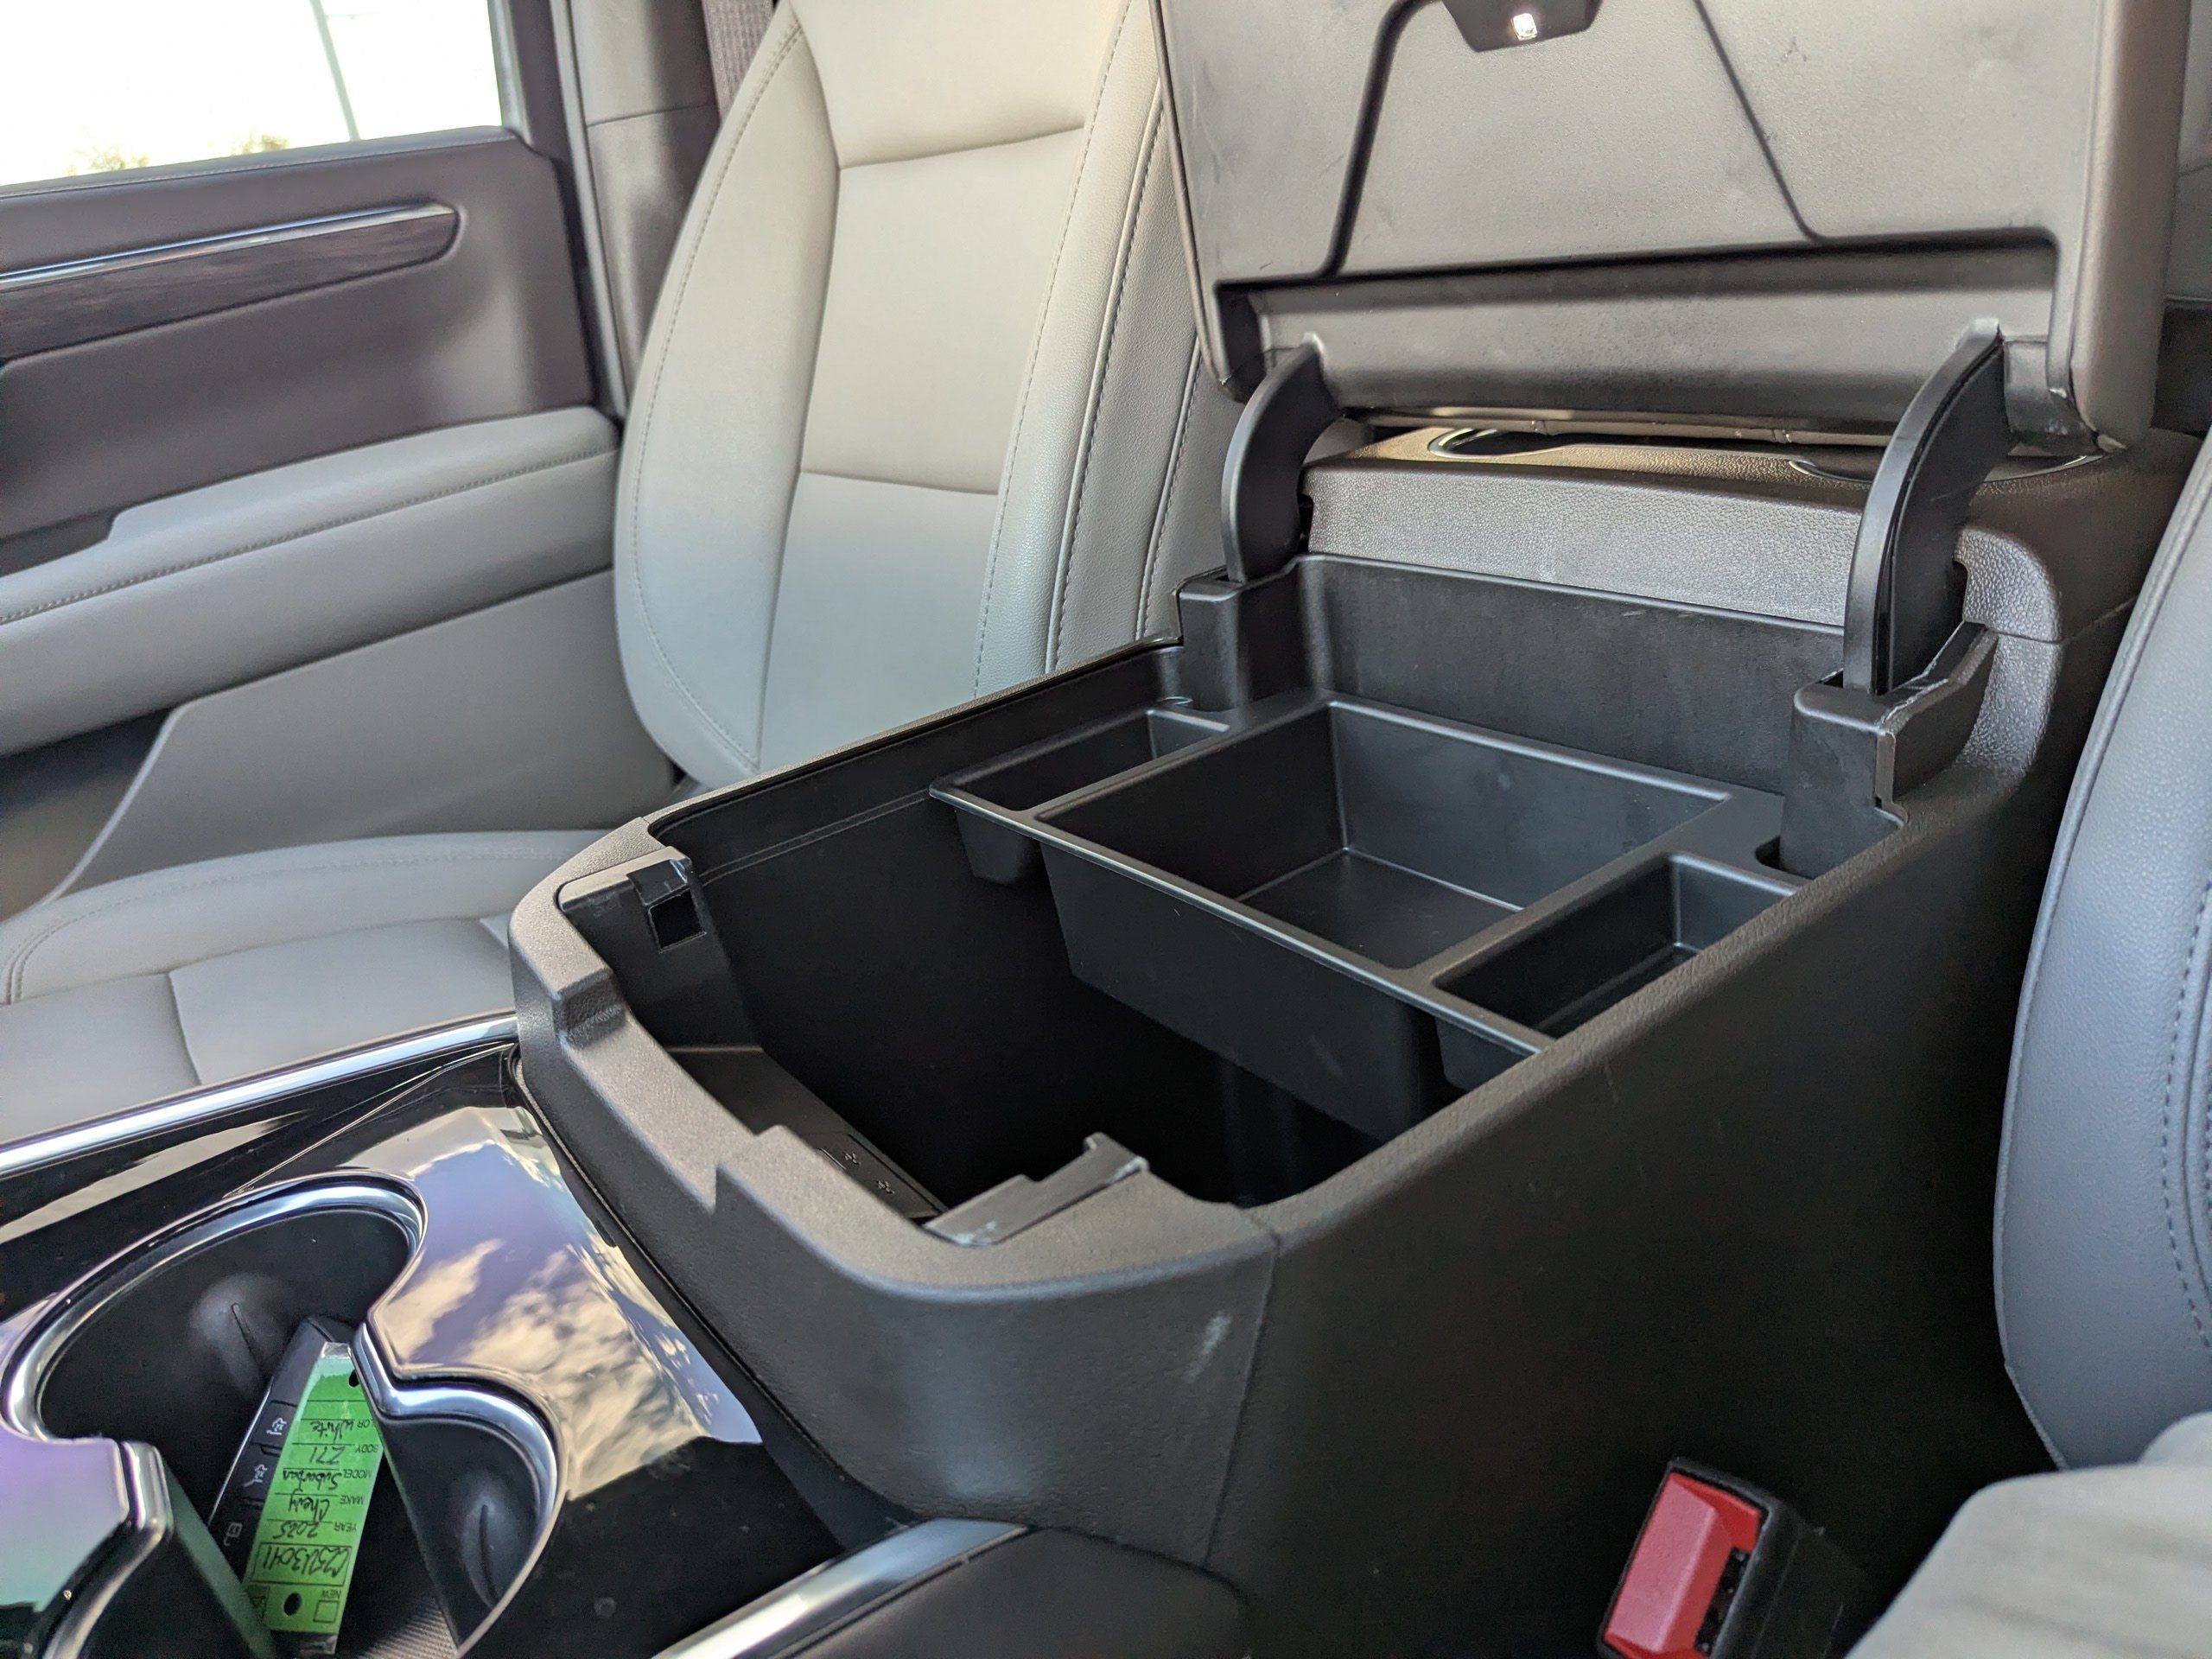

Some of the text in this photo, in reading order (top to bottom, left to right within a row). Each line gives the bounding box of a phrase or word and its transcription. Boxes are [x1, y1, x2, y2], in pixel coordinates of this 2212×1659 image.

[355, 1444, 378, 1453] BODY
[342, 1468, 372, 1479] MODEL
[288, 1488, 365, 1523] MAKE Chevy
[272, 1520, 357, 1539] YEAR 2025
[321, 1589, 342, 1599] NEW
